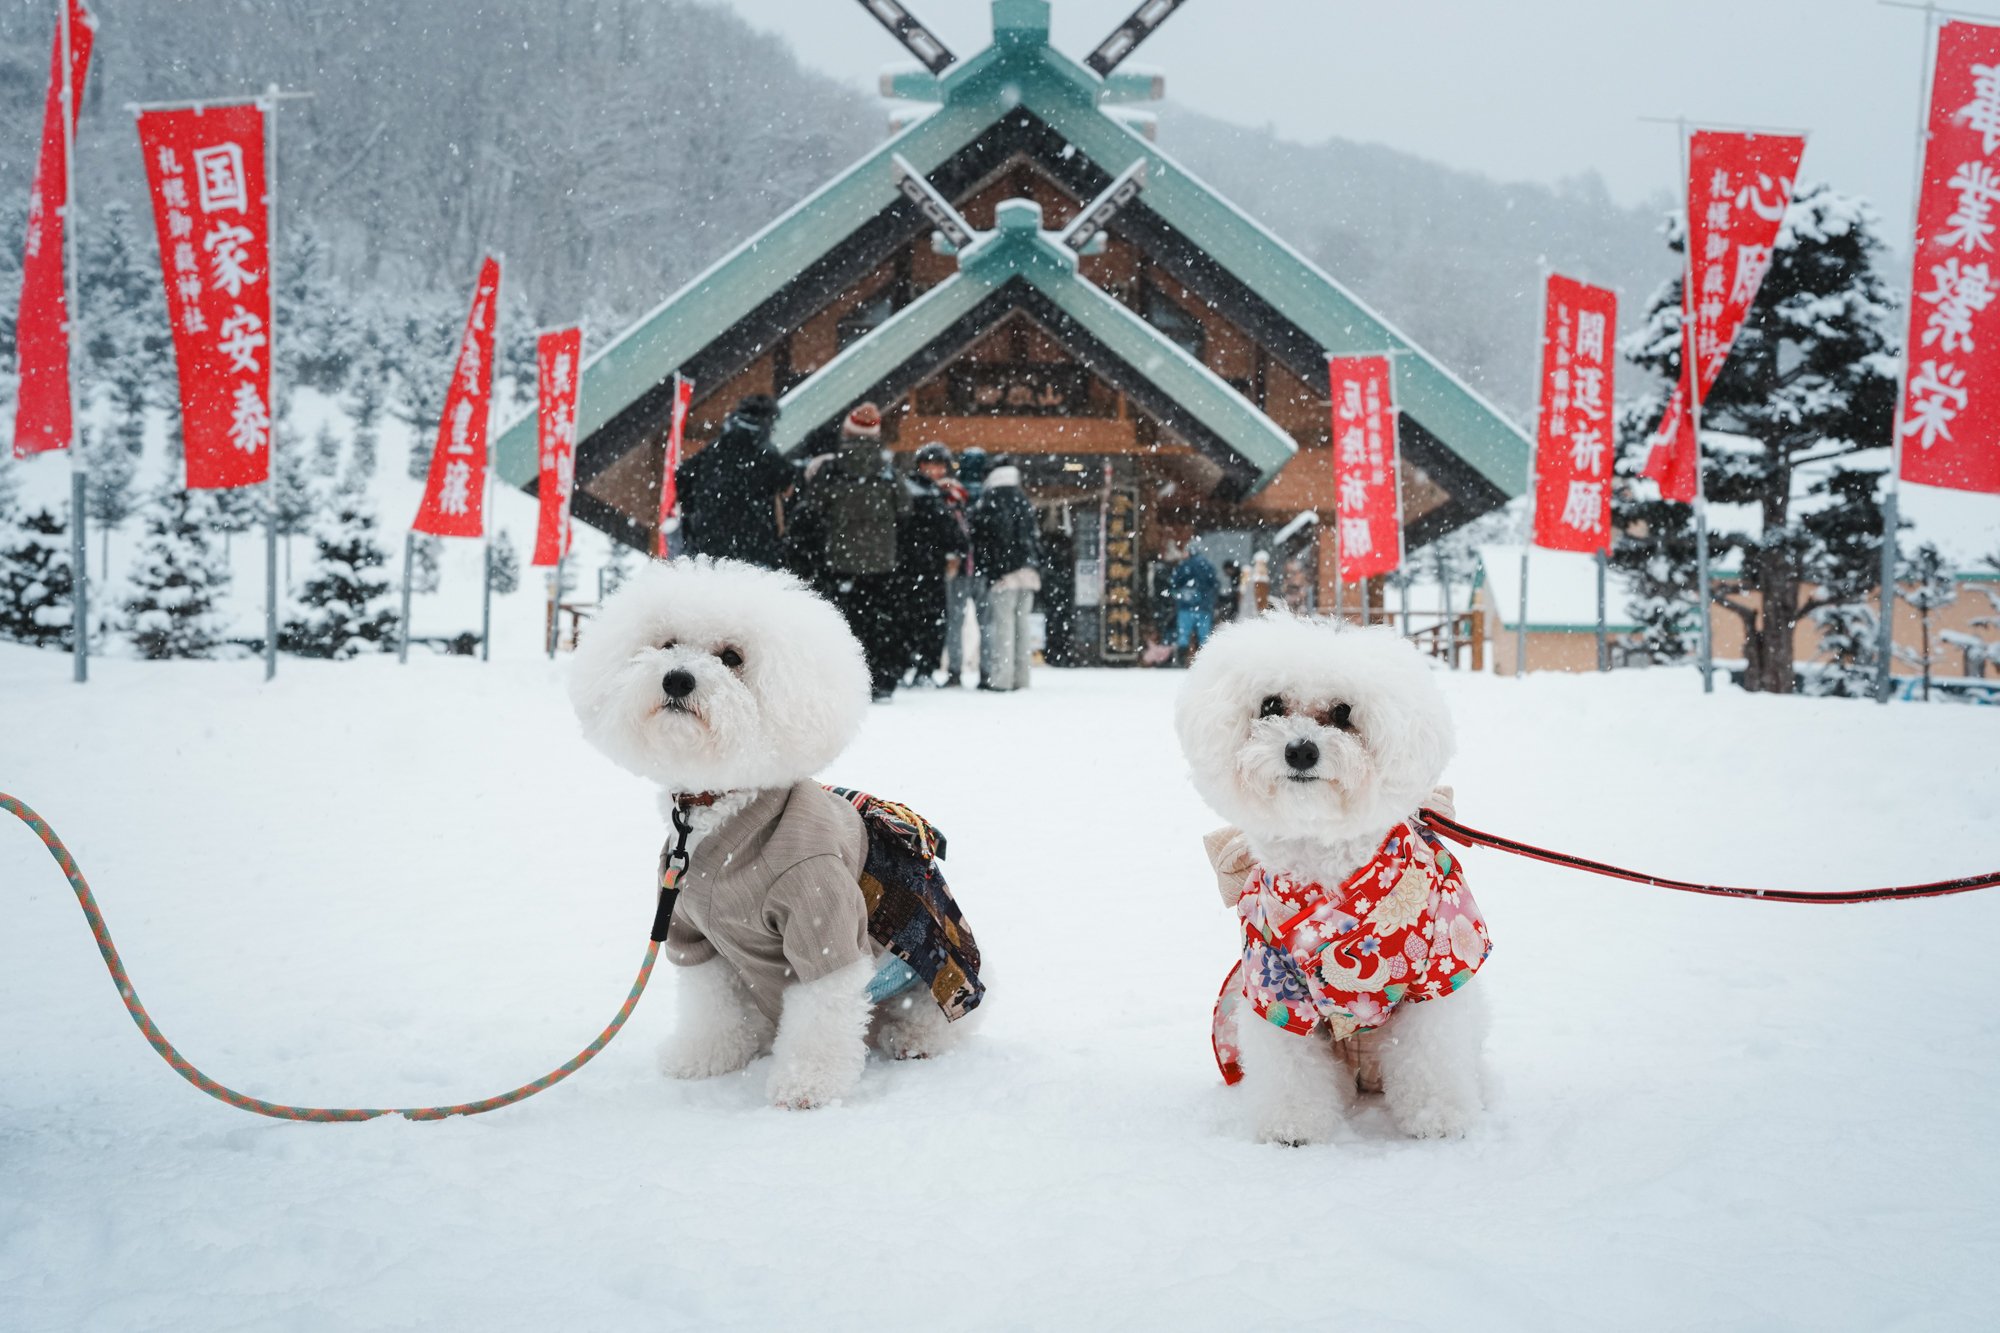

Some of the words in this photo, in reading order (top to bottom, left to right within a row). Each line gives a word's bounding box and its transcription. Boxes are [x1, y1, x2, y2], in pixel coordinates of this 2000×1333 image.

[193, 141, 270, 455] 国家安泰
[1560, 309, 1606, 535] 開運祈願
